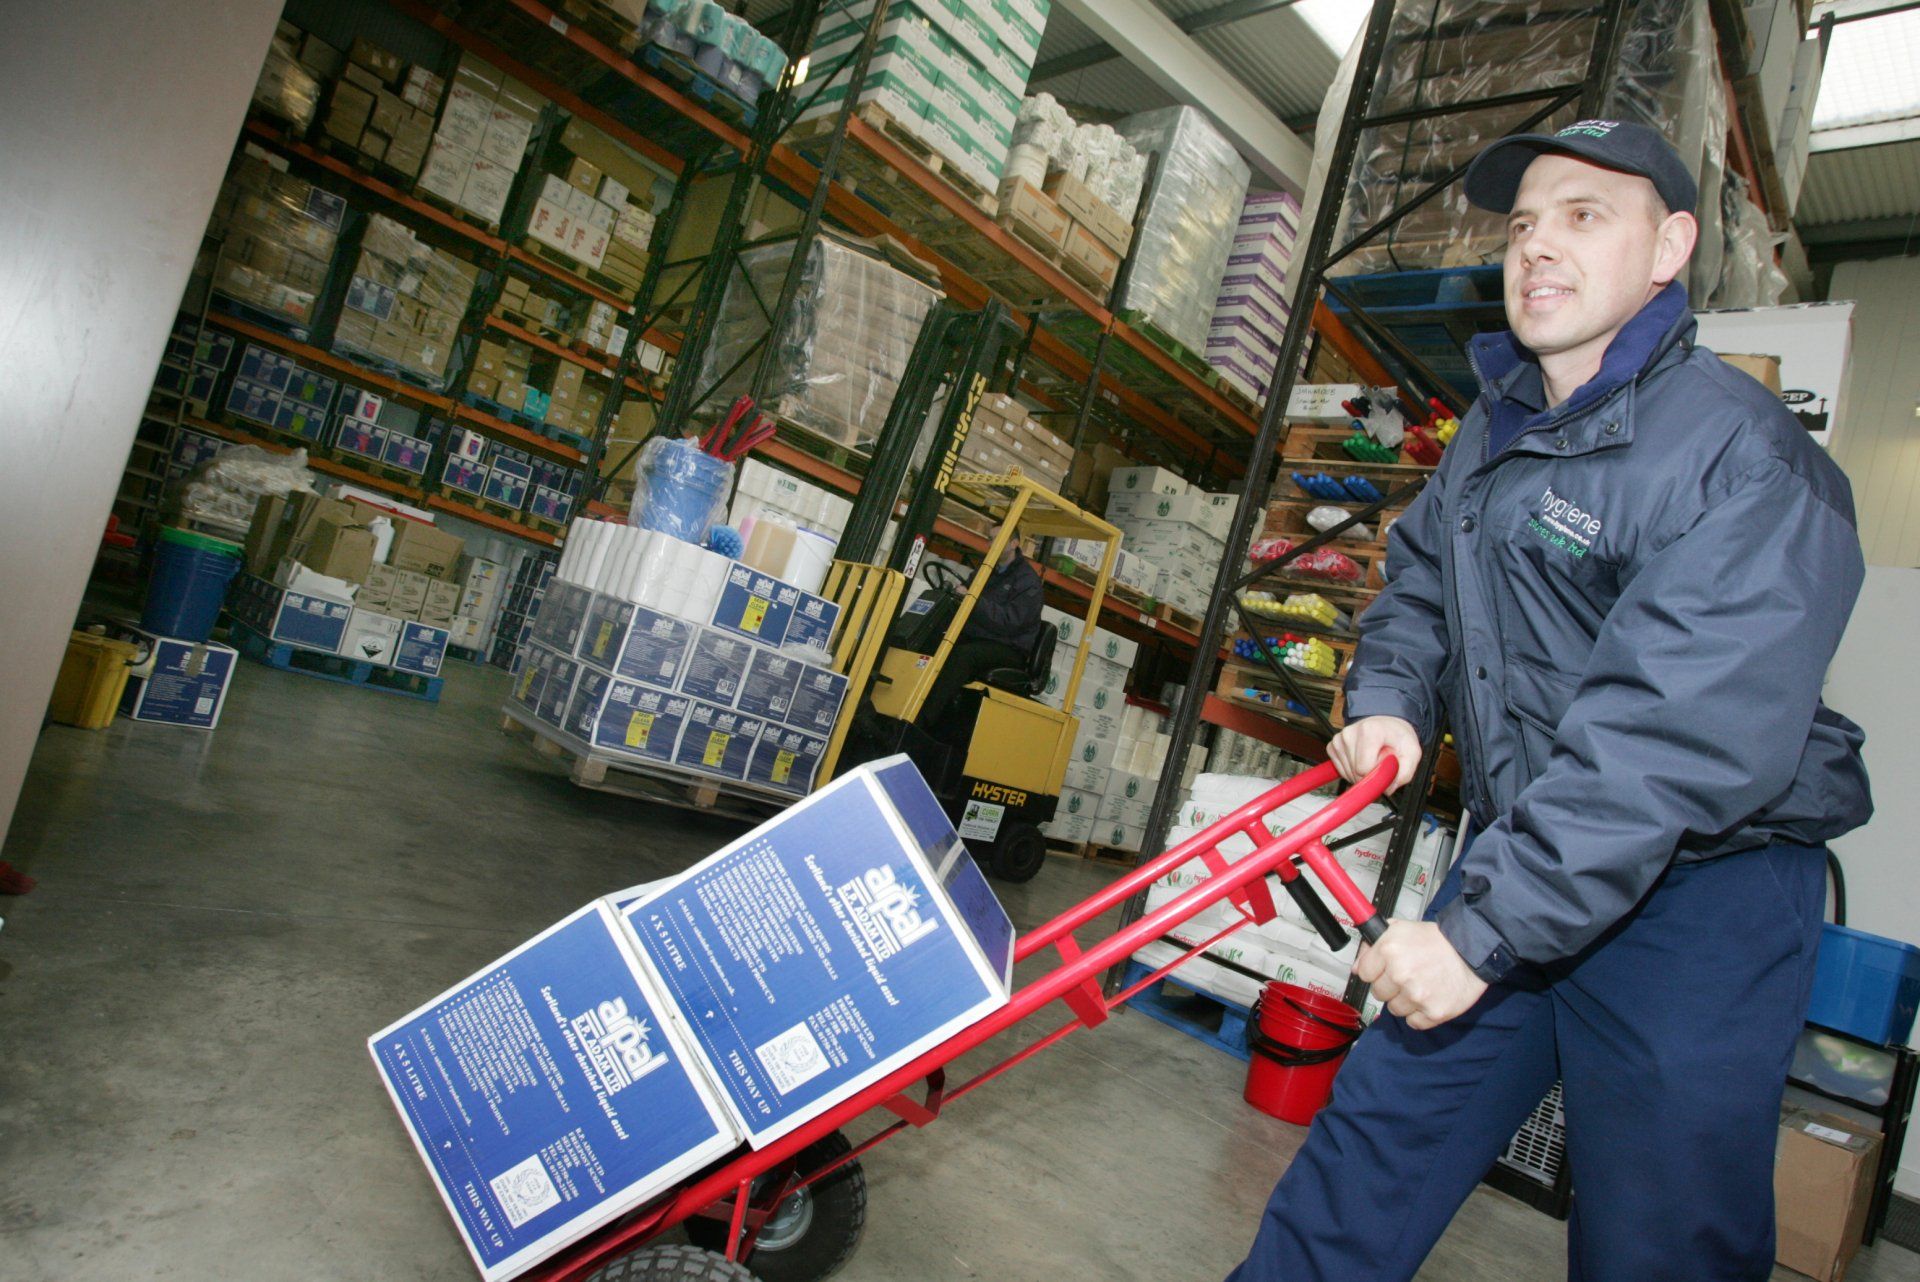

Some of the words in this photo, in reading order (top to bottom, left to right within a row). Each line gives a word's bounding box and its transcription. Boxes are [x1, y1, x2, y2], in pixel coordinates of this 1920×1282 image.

[934, 372, 986, 494] HYSTER
[1541, 486, 1601, 535] hygiene
[1550, 534, 1566, 549] uk
[1568, 541, 1587, 558] ltd
[972, 782, 1027, 806] HYSTER
[801, 853, 835, 897] Scotland's
[827, 895, 848, 920] other
[840, 917, 872, 958] cherished
[861, 956, 887, 986] liquid
[879, 982, 900, 1006] asset
[839, 882, 858, 904] R.P.
[853, 905, 880, 939] ADAM
[872, 938, 892, 961] LTD
[860, 861, 939, 947] arpal
[662, 938, 687, 971] LITRE
[538, 984, 569, 1029] Scotland's
[562, 1027, 581, 1052] other
[574, 1050, 602, 1092] cherished
[593, 1089, 617, 1120] liquid
[609, 1116, 629, 1141] asset
[574, 1014, 592, 1037] R.P.
[586, 1037, 611, 1072] ADAM
[604, 1071, 622, 1093] LTD
[594, 993, 669, 1081] arpal
[405, 1066, 428, 1100] LITRE
[726, 1049, 748, 1077] THIS
[742, 1075, 762, 1100] WAY
[756, 1098, 772, 1116] UP
[463, 1181, 482, 1209] THIS
[476, 1207, 495, 1233] WAY
[489, 1231, 504, 1250] UP
